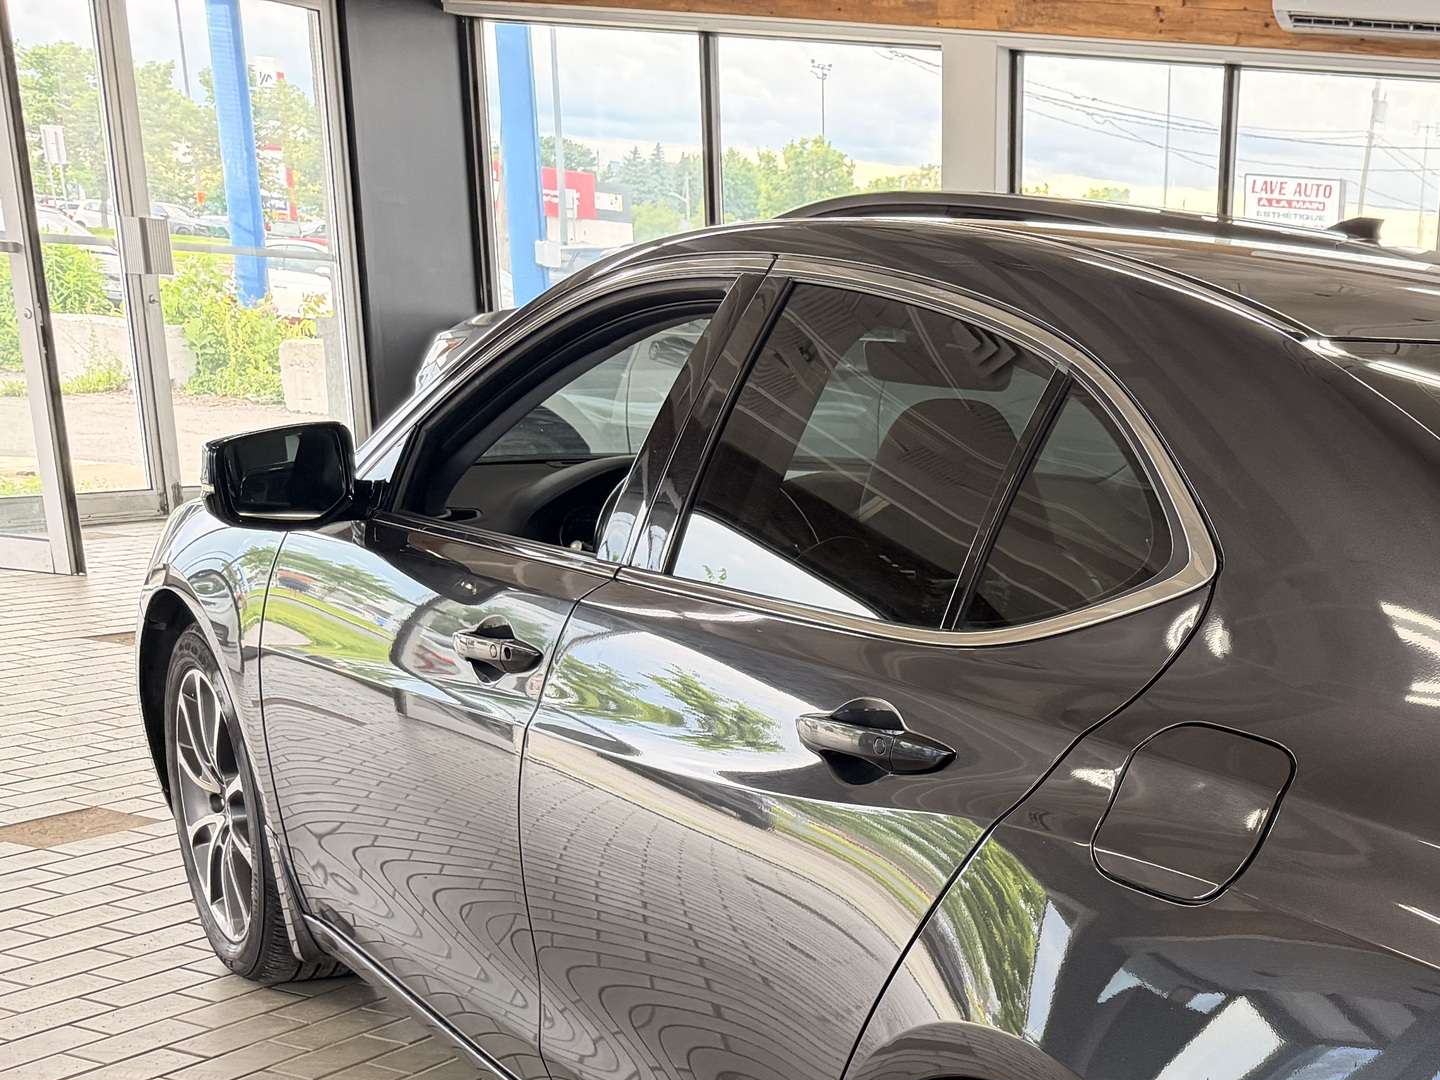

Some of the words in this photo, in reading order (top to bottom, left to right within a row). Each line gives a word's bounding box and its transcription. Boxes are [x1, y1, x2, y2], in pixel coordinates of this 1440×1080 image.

[1251, 179, 1288, 196] LAVE
[1293, 182, 1333, 199] AUTO
[1271, 199, 1289, 208] LA
[1291, 200, 1324, 211] MAIN
